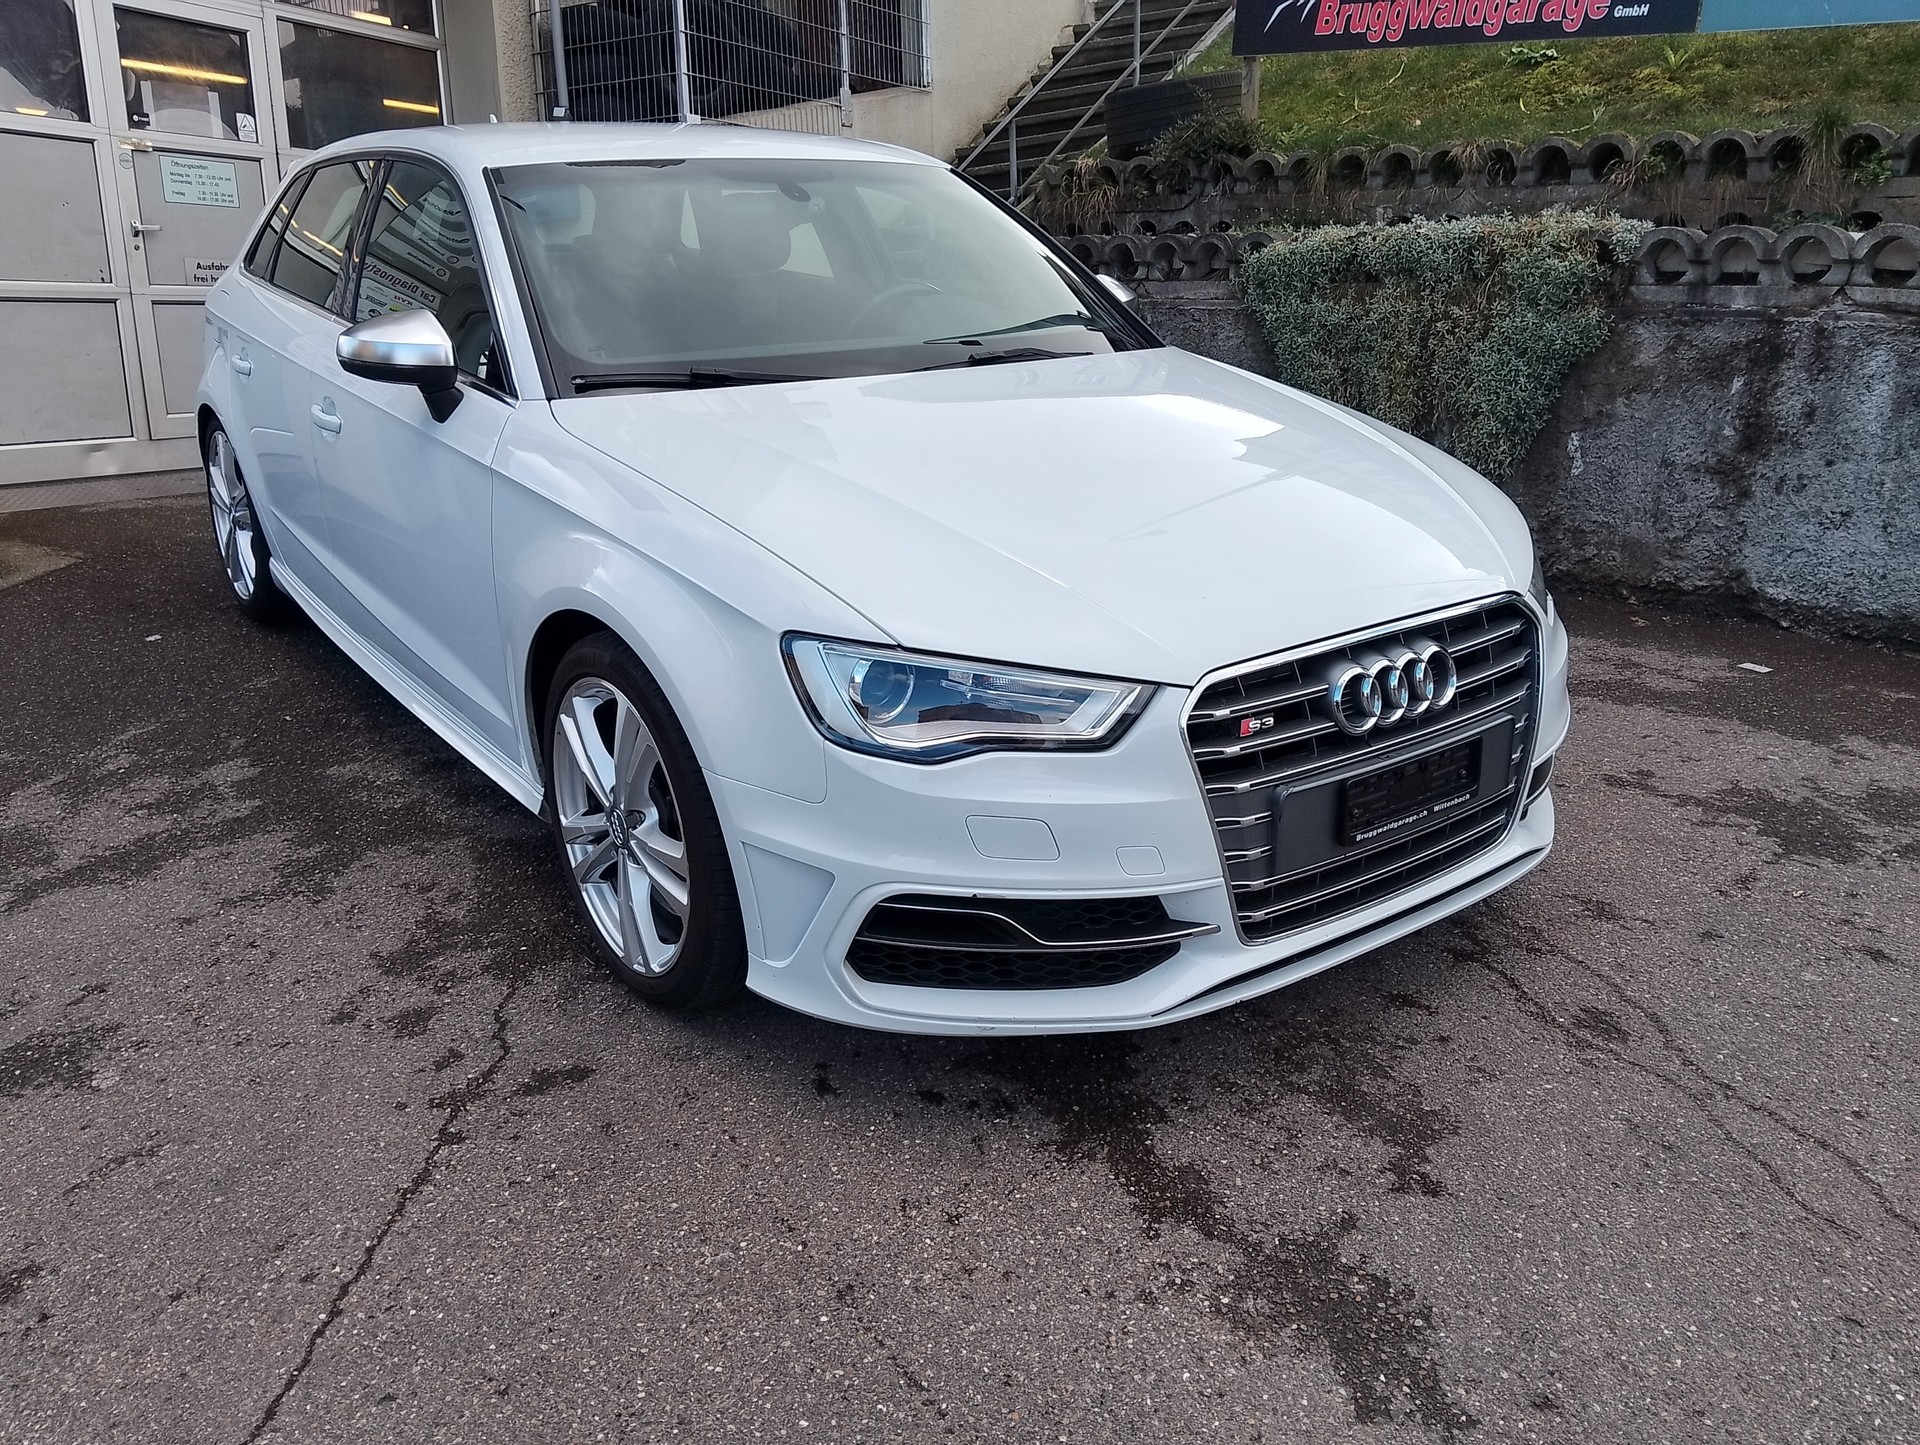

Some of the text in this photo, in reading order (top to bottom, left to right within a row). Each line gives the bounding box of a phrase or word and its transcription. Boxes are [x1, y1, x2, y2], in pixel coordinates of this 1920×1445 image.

[1613, 4, 1650, 18] GmbH
[170, 160, 209, 170] Öffnungszeiten
[170, 178, 192, 186] Donnerstag
[196, 261, 230, 271] Ausfahr
[193, 273, 209, 282] frei
[1249, 716, 1274, 731] S3
[1355, 793, 1470, 842] Bruggwaldgarage.ch Wittenbach
